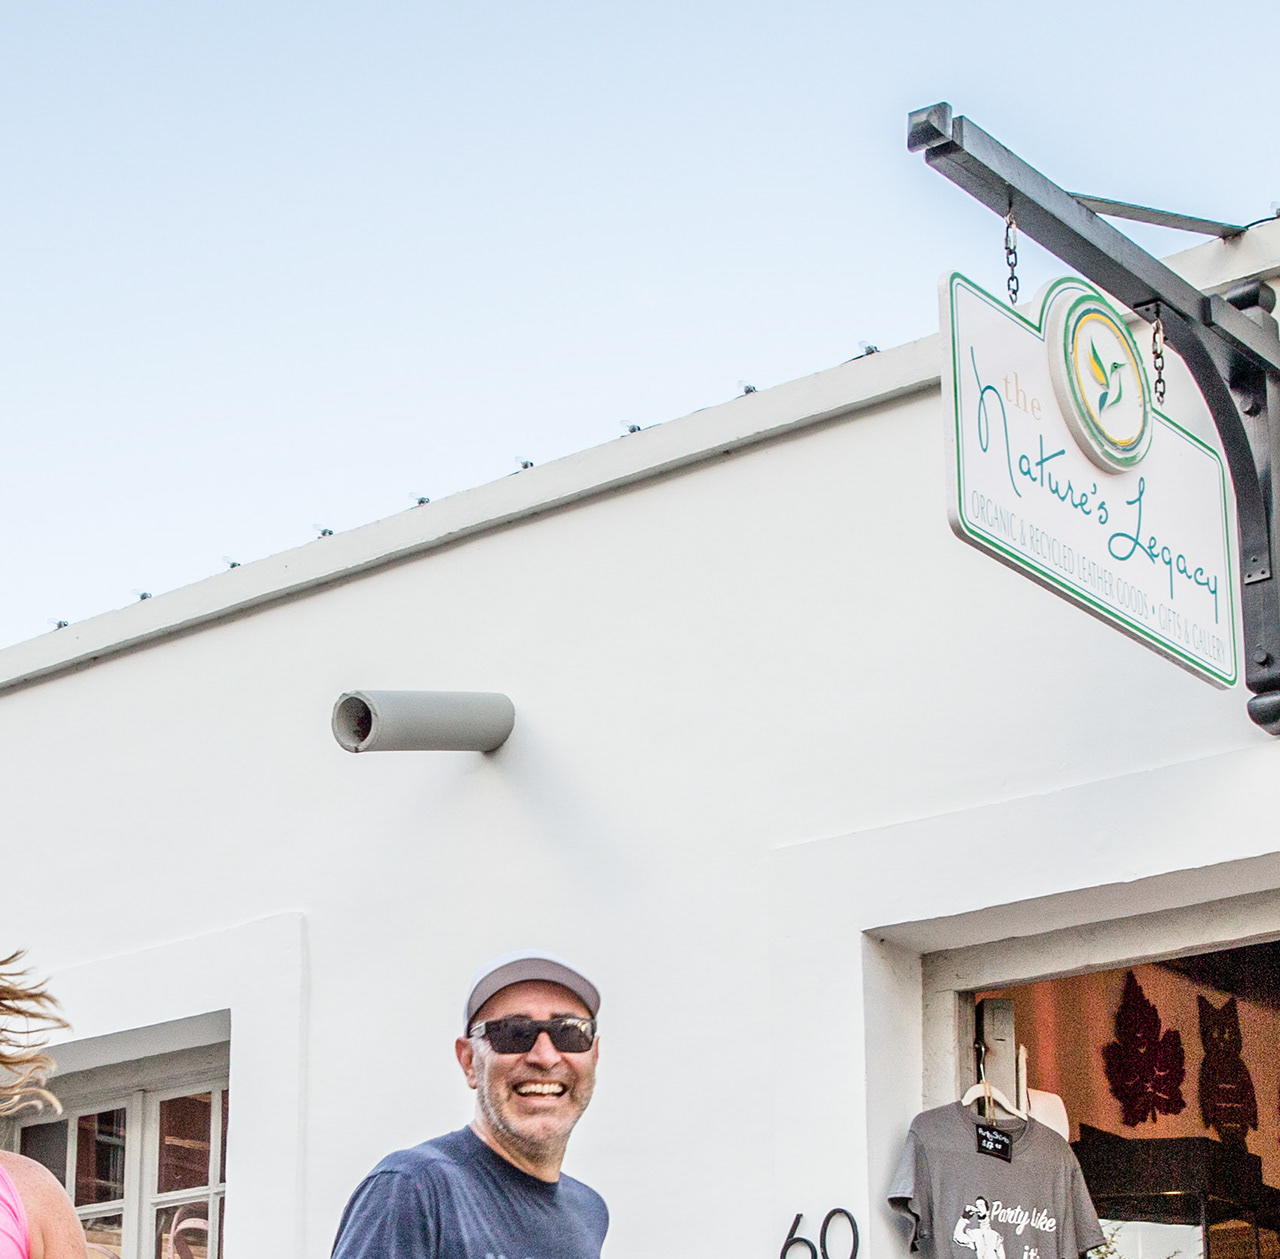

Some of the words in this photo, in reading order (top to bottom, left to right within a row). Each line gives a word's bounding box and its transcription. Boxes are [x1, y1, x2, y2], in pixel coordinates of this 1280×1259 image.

[1003, 371, 1042, 421] the
[970, 346, 1110, 526] Nature's
[1107, 476, 1219, 624] Legacy
[971, 490, 1017, 542] ORGANIC
[1029, 523, 1075, 576] RECYCLED
[1077, 552, 1115, 601] LEATHER
[1116, 576, 1151, 620] GOODS
[1158, 602, 1183, 641] GIFTS
[1191, 622, 1226, 666] GALLERY
[990, 1200, 1030, 1235] Party
